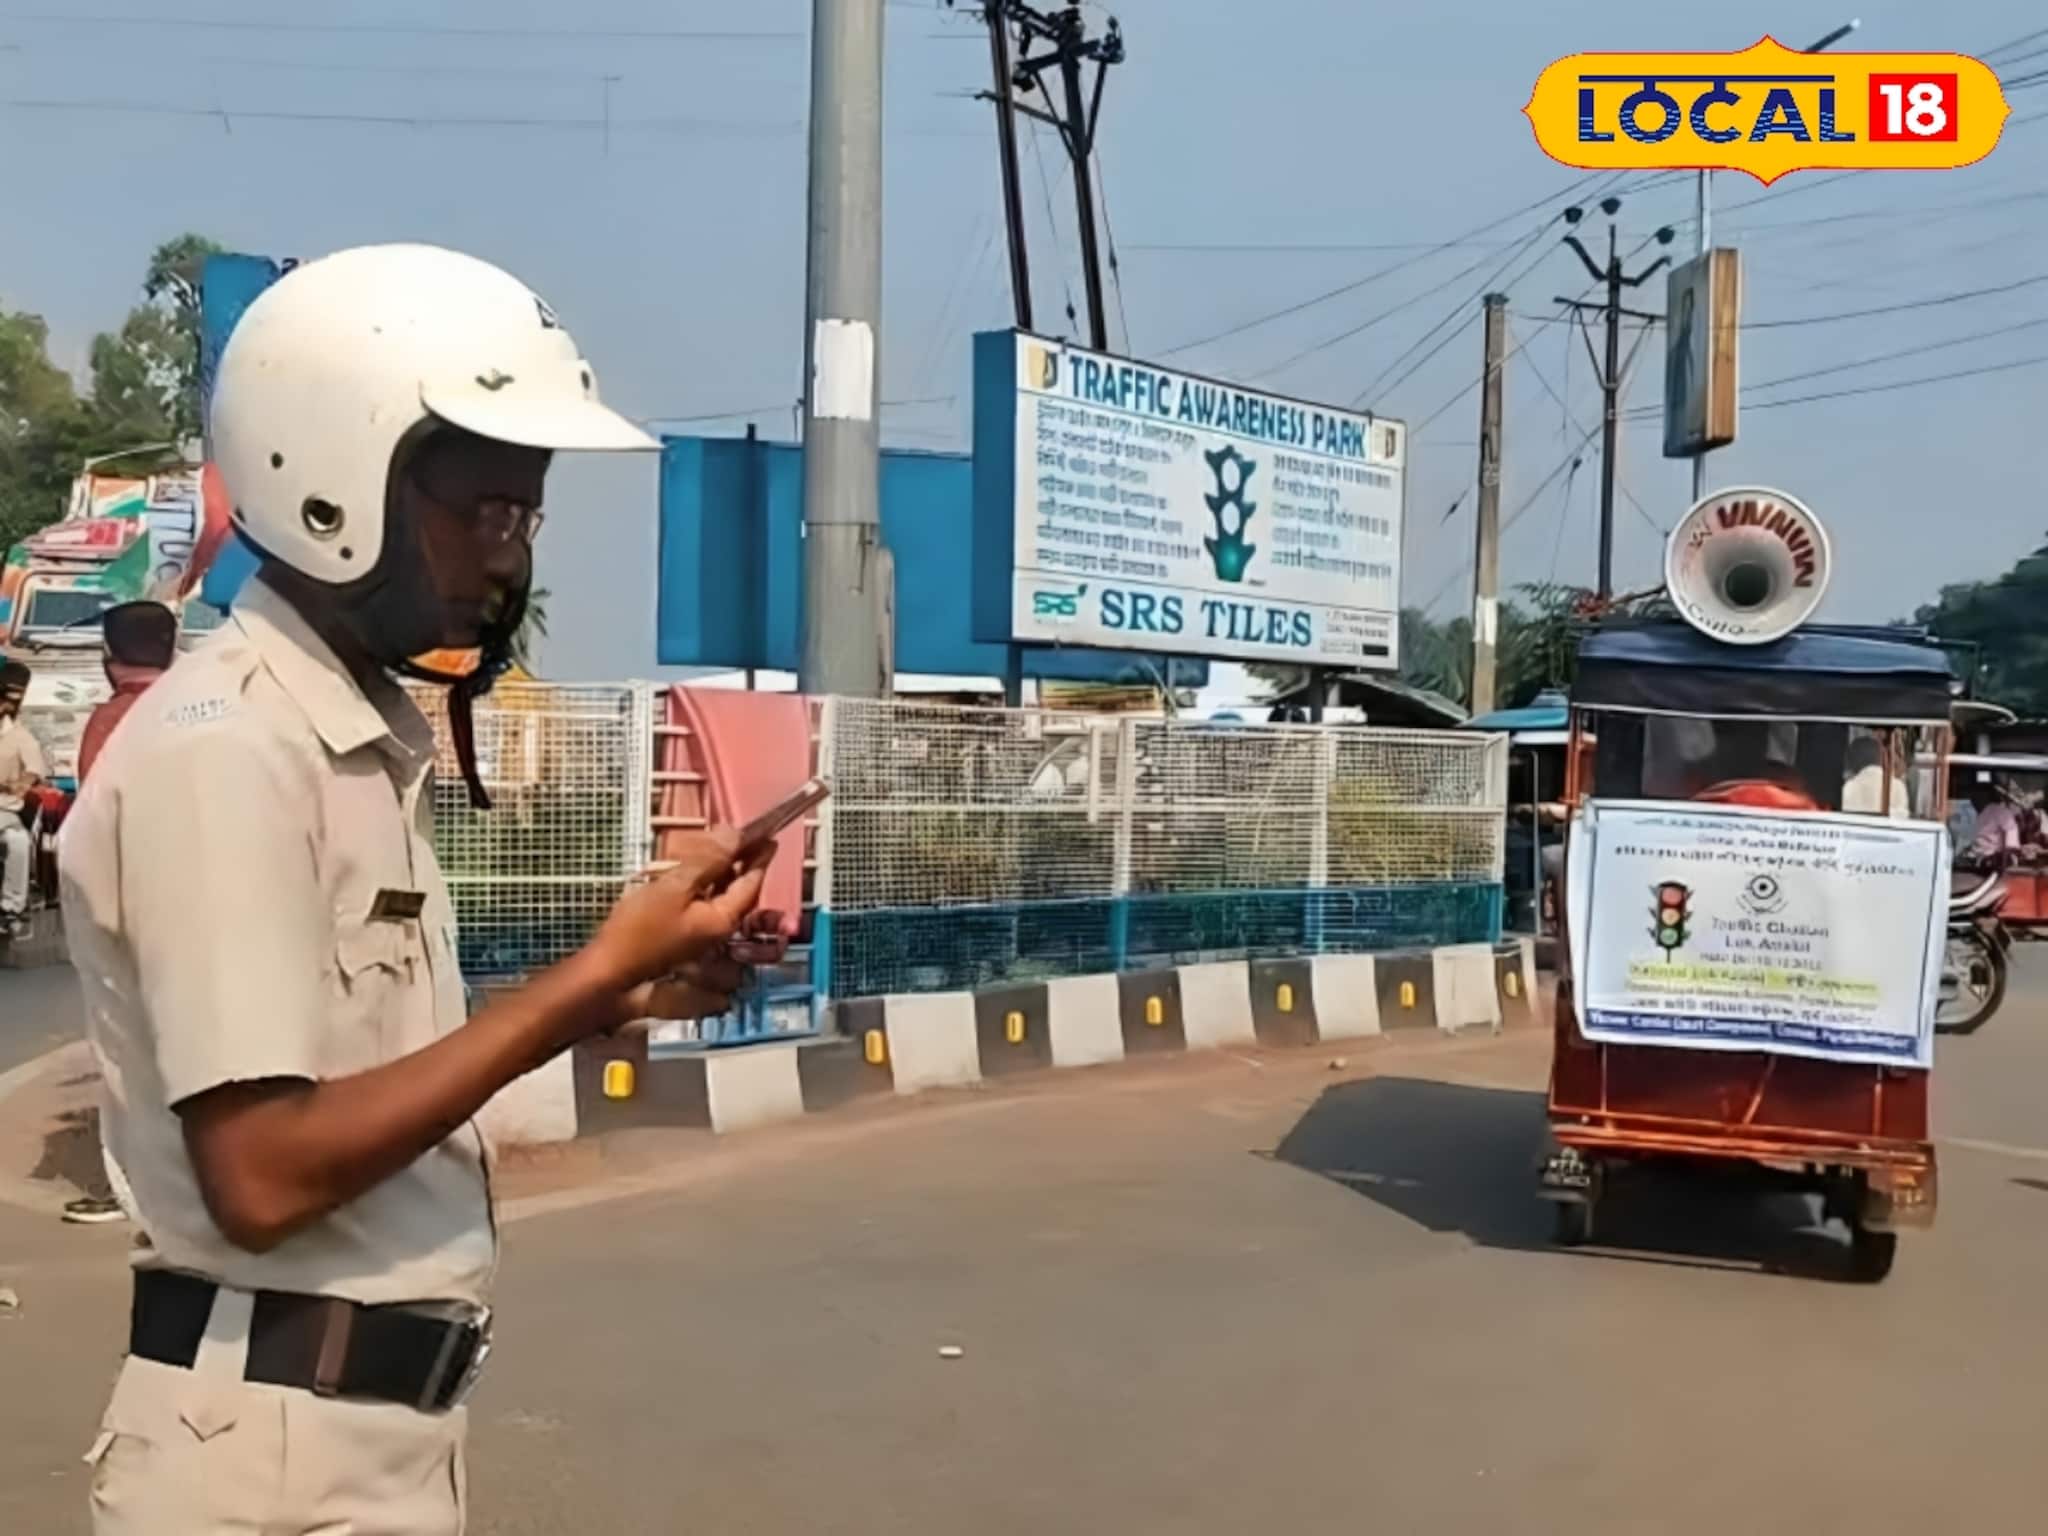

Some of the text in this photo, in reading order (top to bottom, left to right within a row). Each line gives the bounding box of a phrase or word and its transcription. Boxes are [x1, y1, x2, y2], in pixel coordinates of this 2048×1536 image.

[1069, 355, 1171, 416] TRAFFIC
[1177, 380, 1305, 446] AWARENESS
[1312, 413, 1367, 458] PARK
[1101, 588, 1183, 635] SRS
[1201, 600, 1312, 648] TILES
